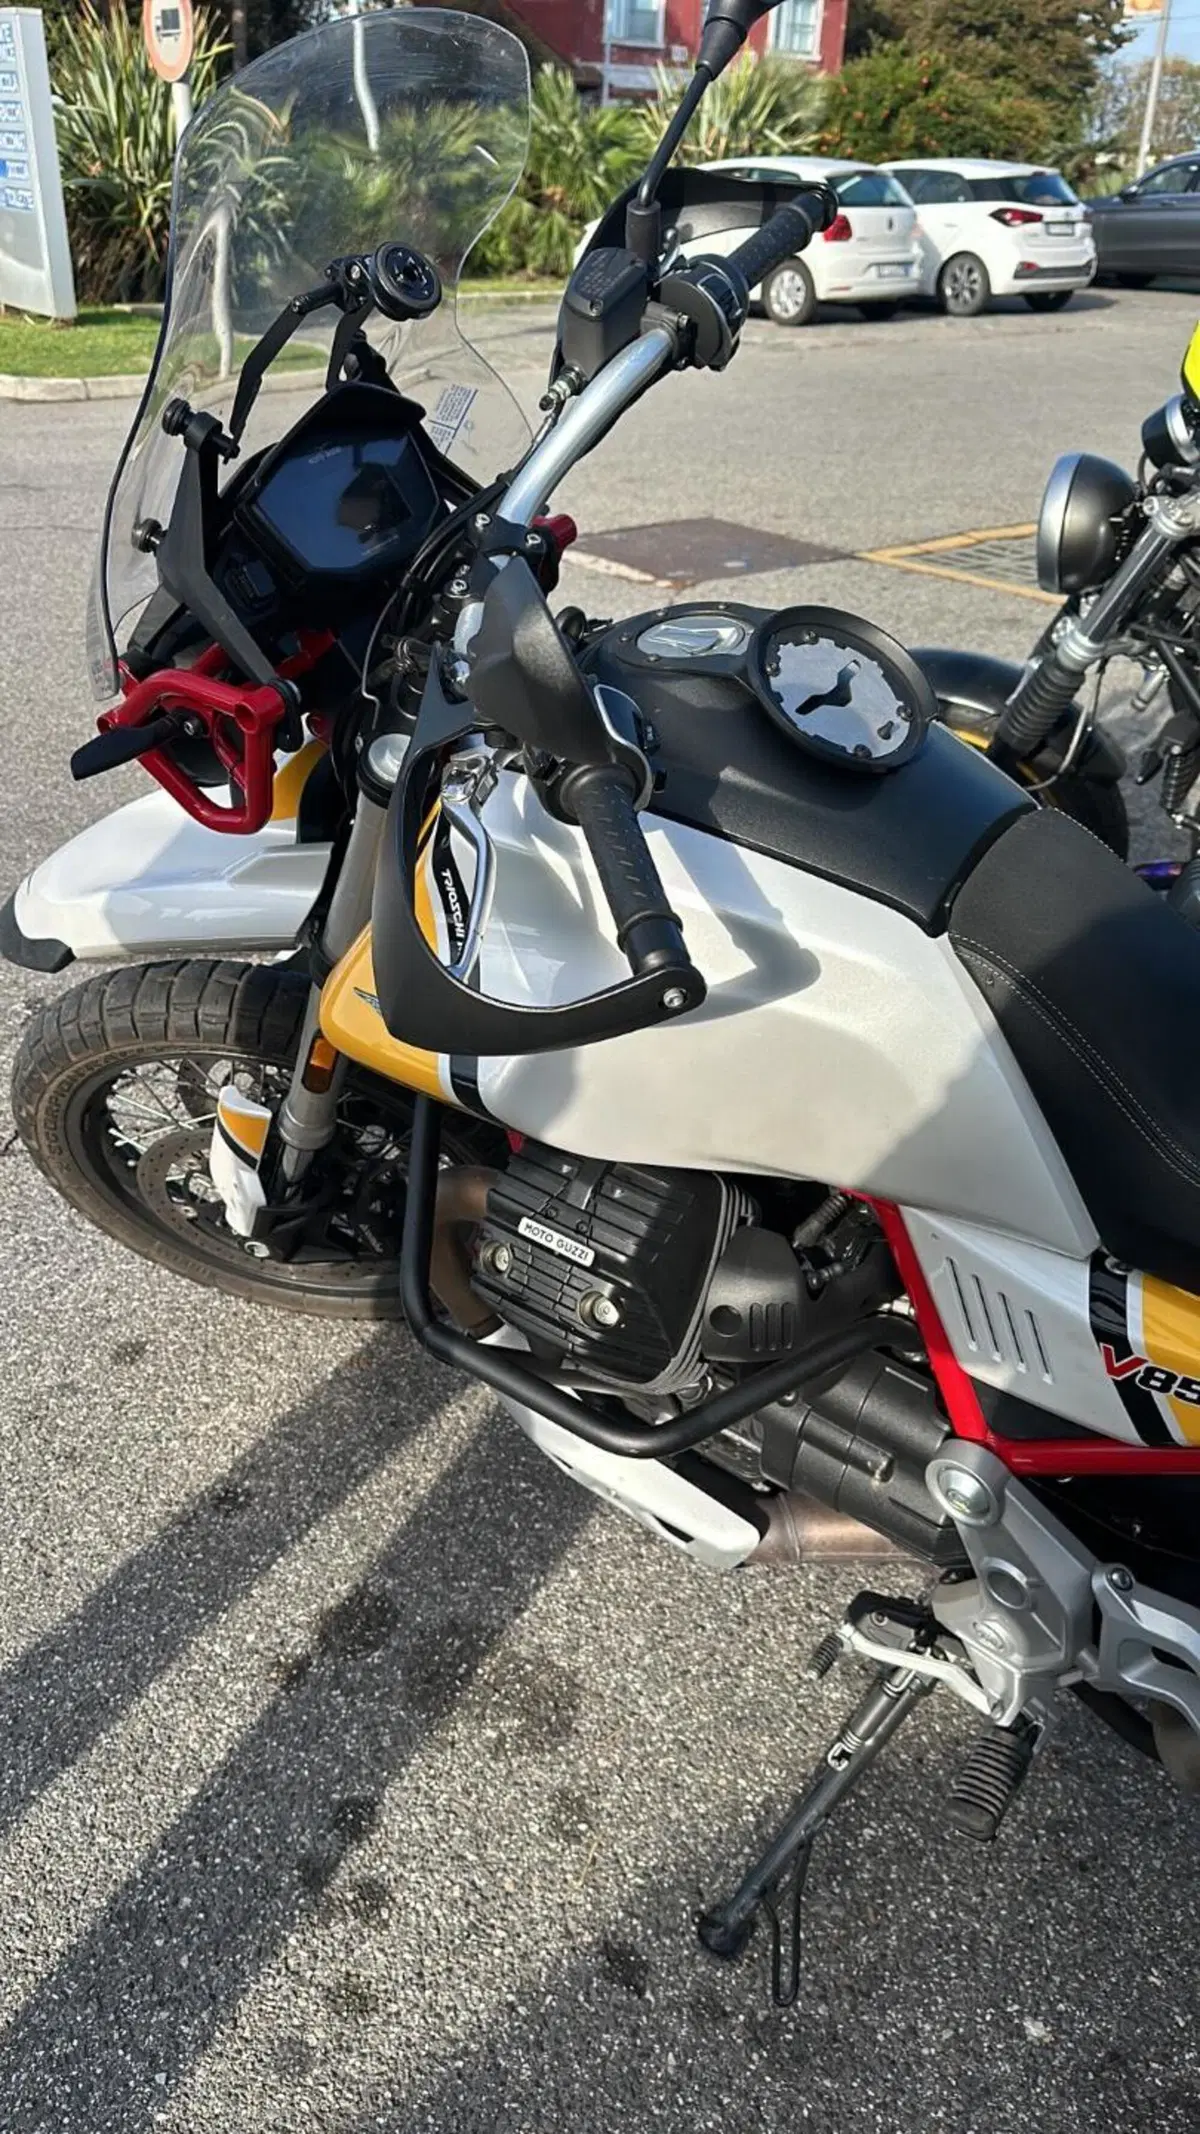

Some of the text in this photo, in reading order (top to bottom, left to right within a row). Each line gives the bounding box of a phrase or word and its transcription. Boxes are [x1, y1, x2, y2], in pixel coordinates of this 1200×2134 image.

[524, 1222, 589, 1260] MOTO GUZZI
[1100, 1342, 1200, 1407] V85
